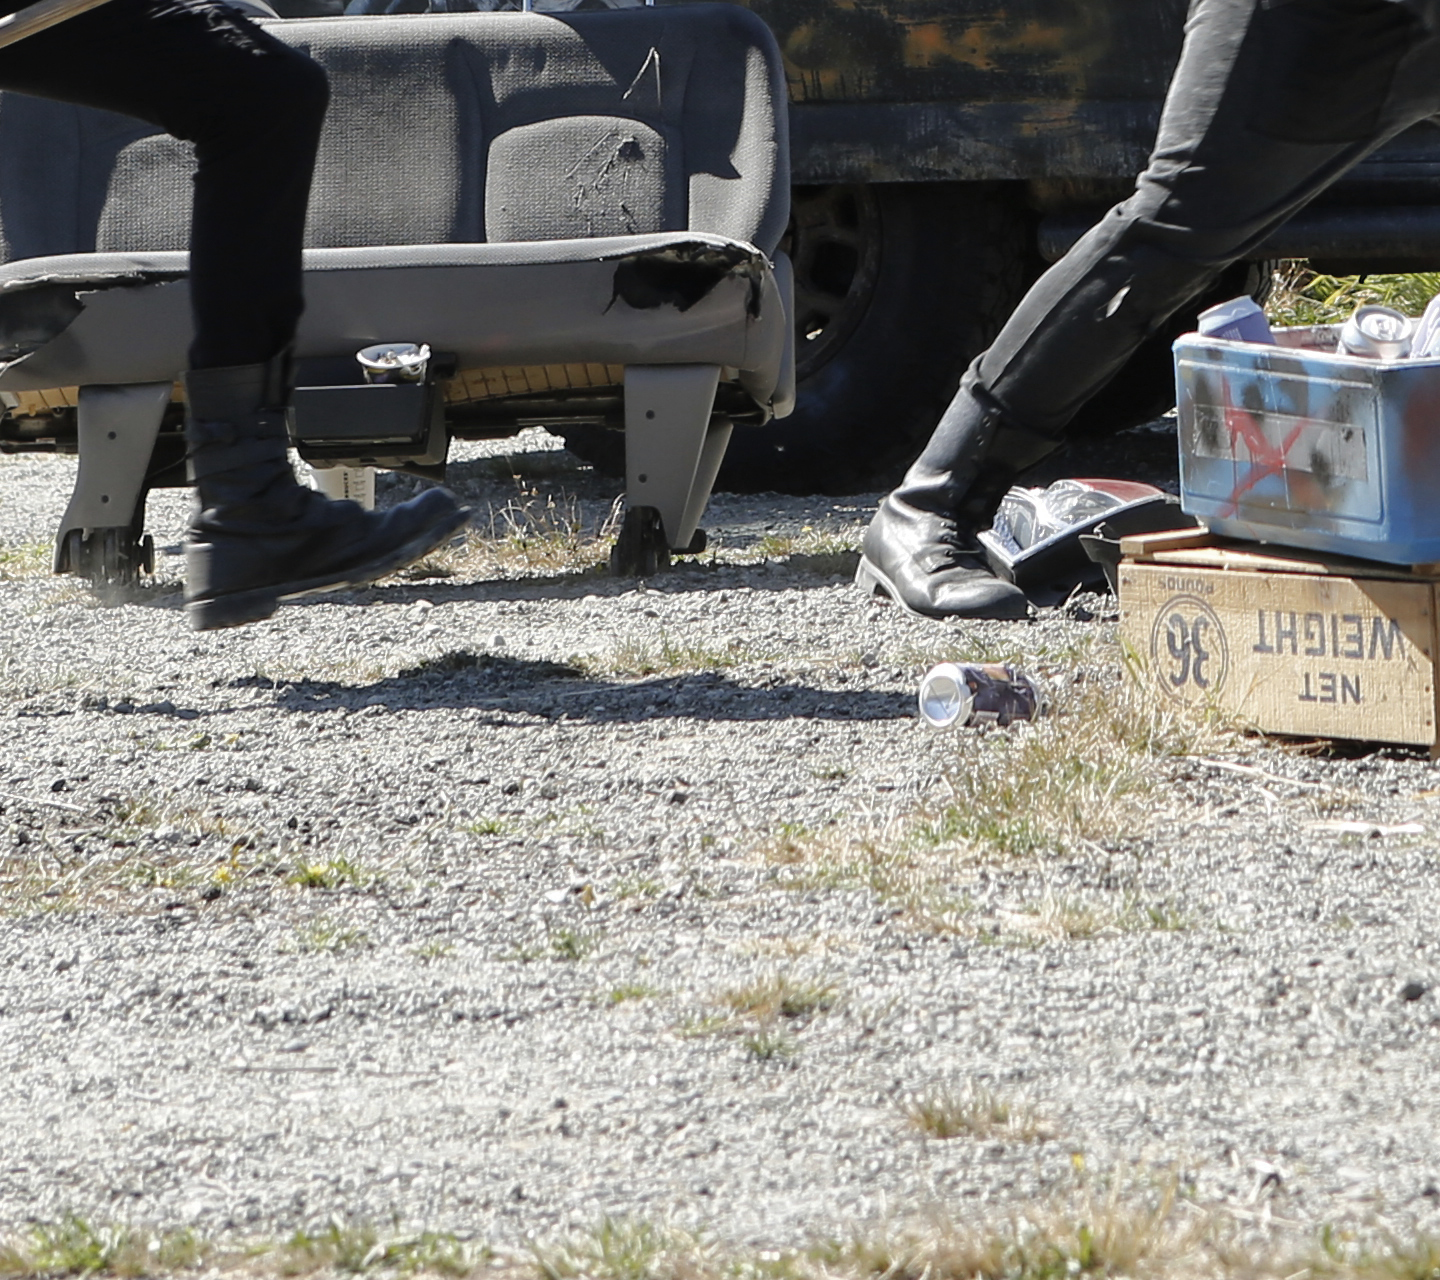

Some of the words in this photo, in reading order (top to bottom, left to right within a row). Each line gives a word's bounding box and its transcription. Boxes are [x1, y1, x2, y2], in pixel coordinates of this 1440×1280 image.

[1166, 613, 1210, 689] 36
[1252, 608, 1407, 662] WEIGHT
[1298, 672, 1362, 705] NET
